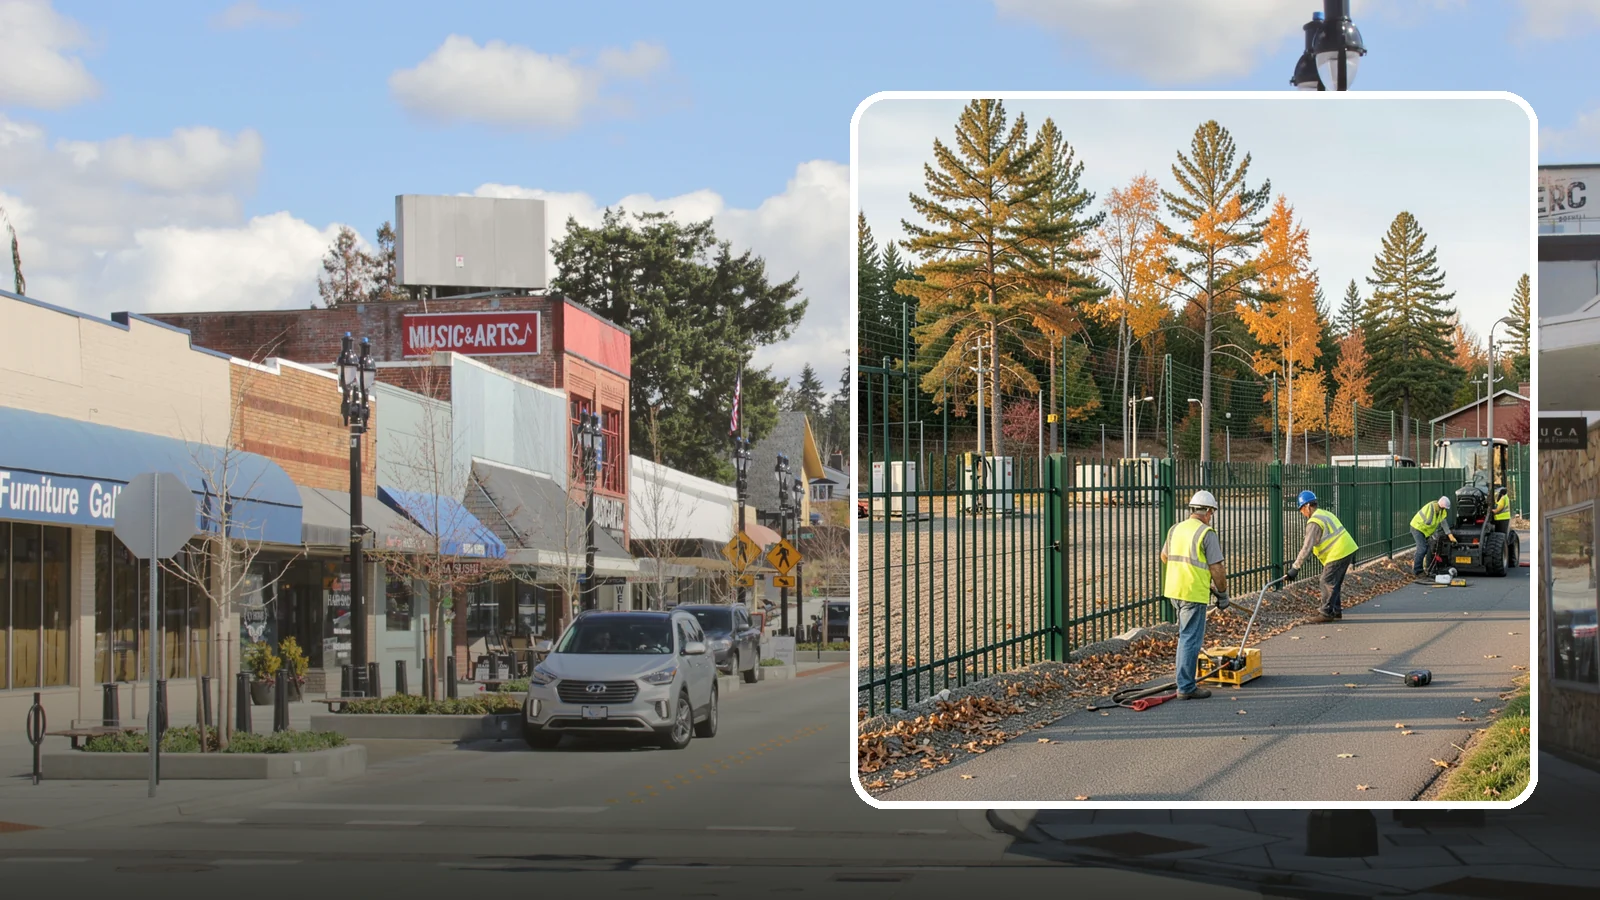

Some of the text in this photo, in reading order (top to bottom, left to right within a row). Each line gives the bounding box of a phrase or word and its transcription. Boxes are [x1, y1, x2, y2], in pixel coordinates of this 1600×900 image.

[409, 322, 520, 349] MUSIC&ARTS
[0, 471, 121, 519] Furniture Gal
[453, 563, 480, 575] SUSHI
